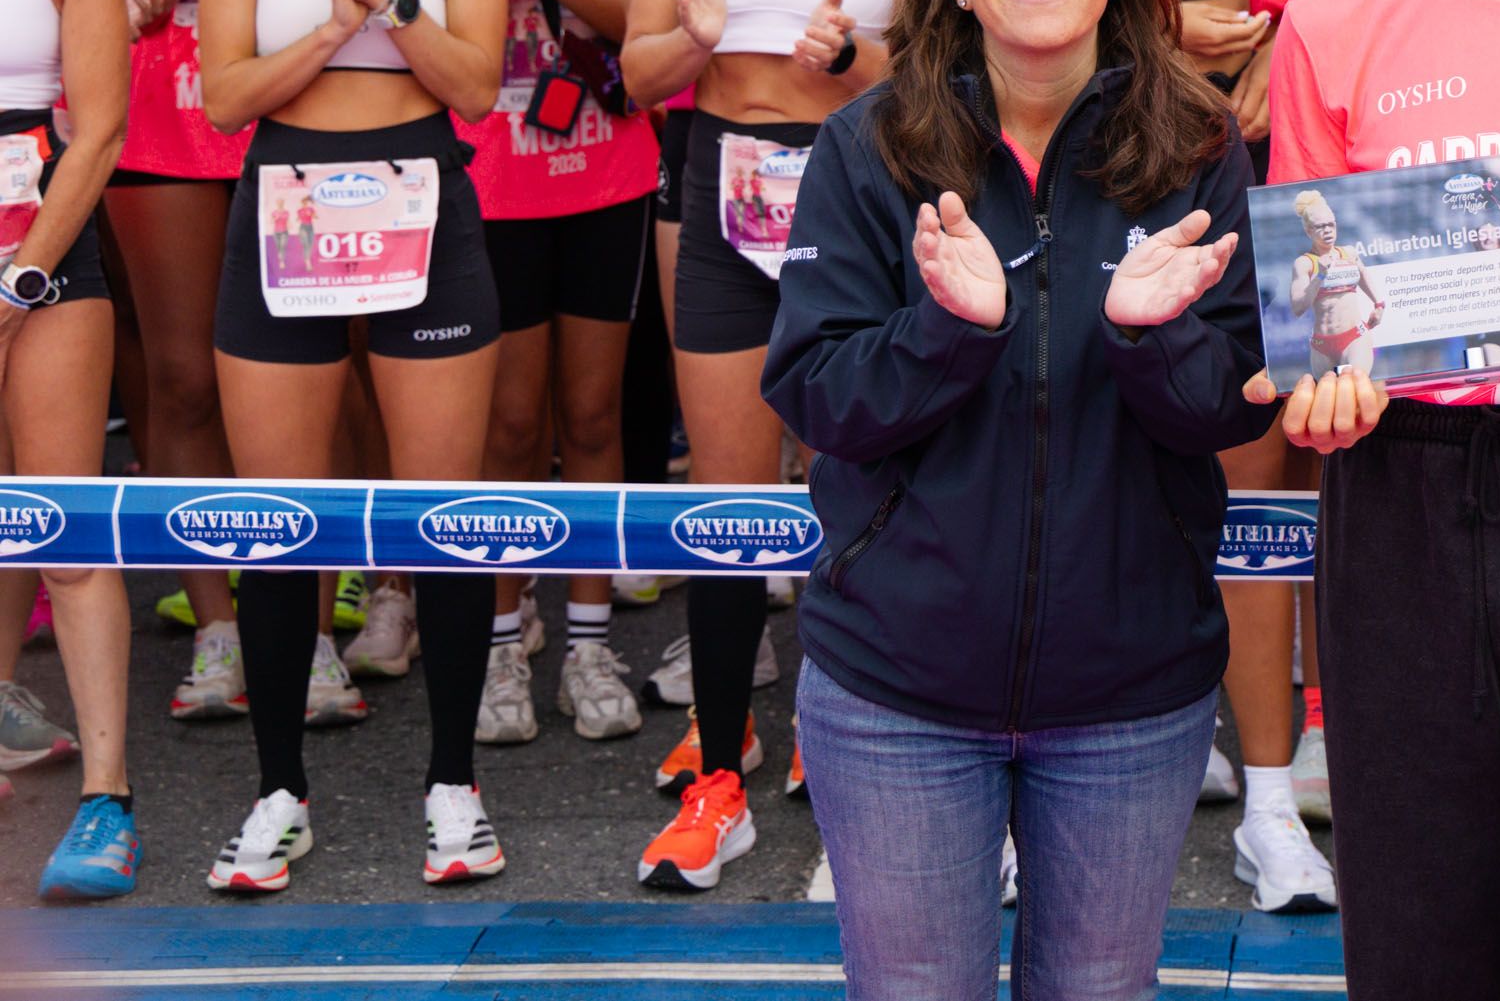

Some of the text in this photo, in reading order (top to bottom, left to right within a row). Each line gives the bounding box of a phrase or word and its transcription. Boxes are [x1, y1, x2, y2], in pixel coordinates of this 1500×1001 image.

[1377, 76, 1467, 115] OYSHO
[547, 152, 588, 177] 2026
[1442, 192, 1476, 204] Carrera
[1464, 200, 1488, 214] Mujer
[318, 232, 384, 258] 016
[1356, 233, 1442, 257] Adiaratou
[1385, 275, 1399, 284] Por
[1410, 269, 1454, 282] trayectoria
[1388, 283, 1439, 297] compromiso
[1440, 278, 1463, 290] social
[282, 295, 337, 308] OYSHO
[1391, 296, 1428, 309] referente
[1428, 294, 1447, 305] para
[1448, 290, 1481, 302] mujeres
[1428, 305, 1457, 317] mundo
[1459, 303, 1471, 312] del
[413, 324, 472, 341] OYSHO
[177, 510, 305, 538] ASTURIANA
[429, 515, 558, 543] ASTURIANA
[682, 517, 812, 545] ASTURIANA
[183, 530, 232, 538] LECHERA
[435, 534, 536, 543] CENTRAL LECHERA
[688, 537, 789, 546] CENTRAL LECHERA
